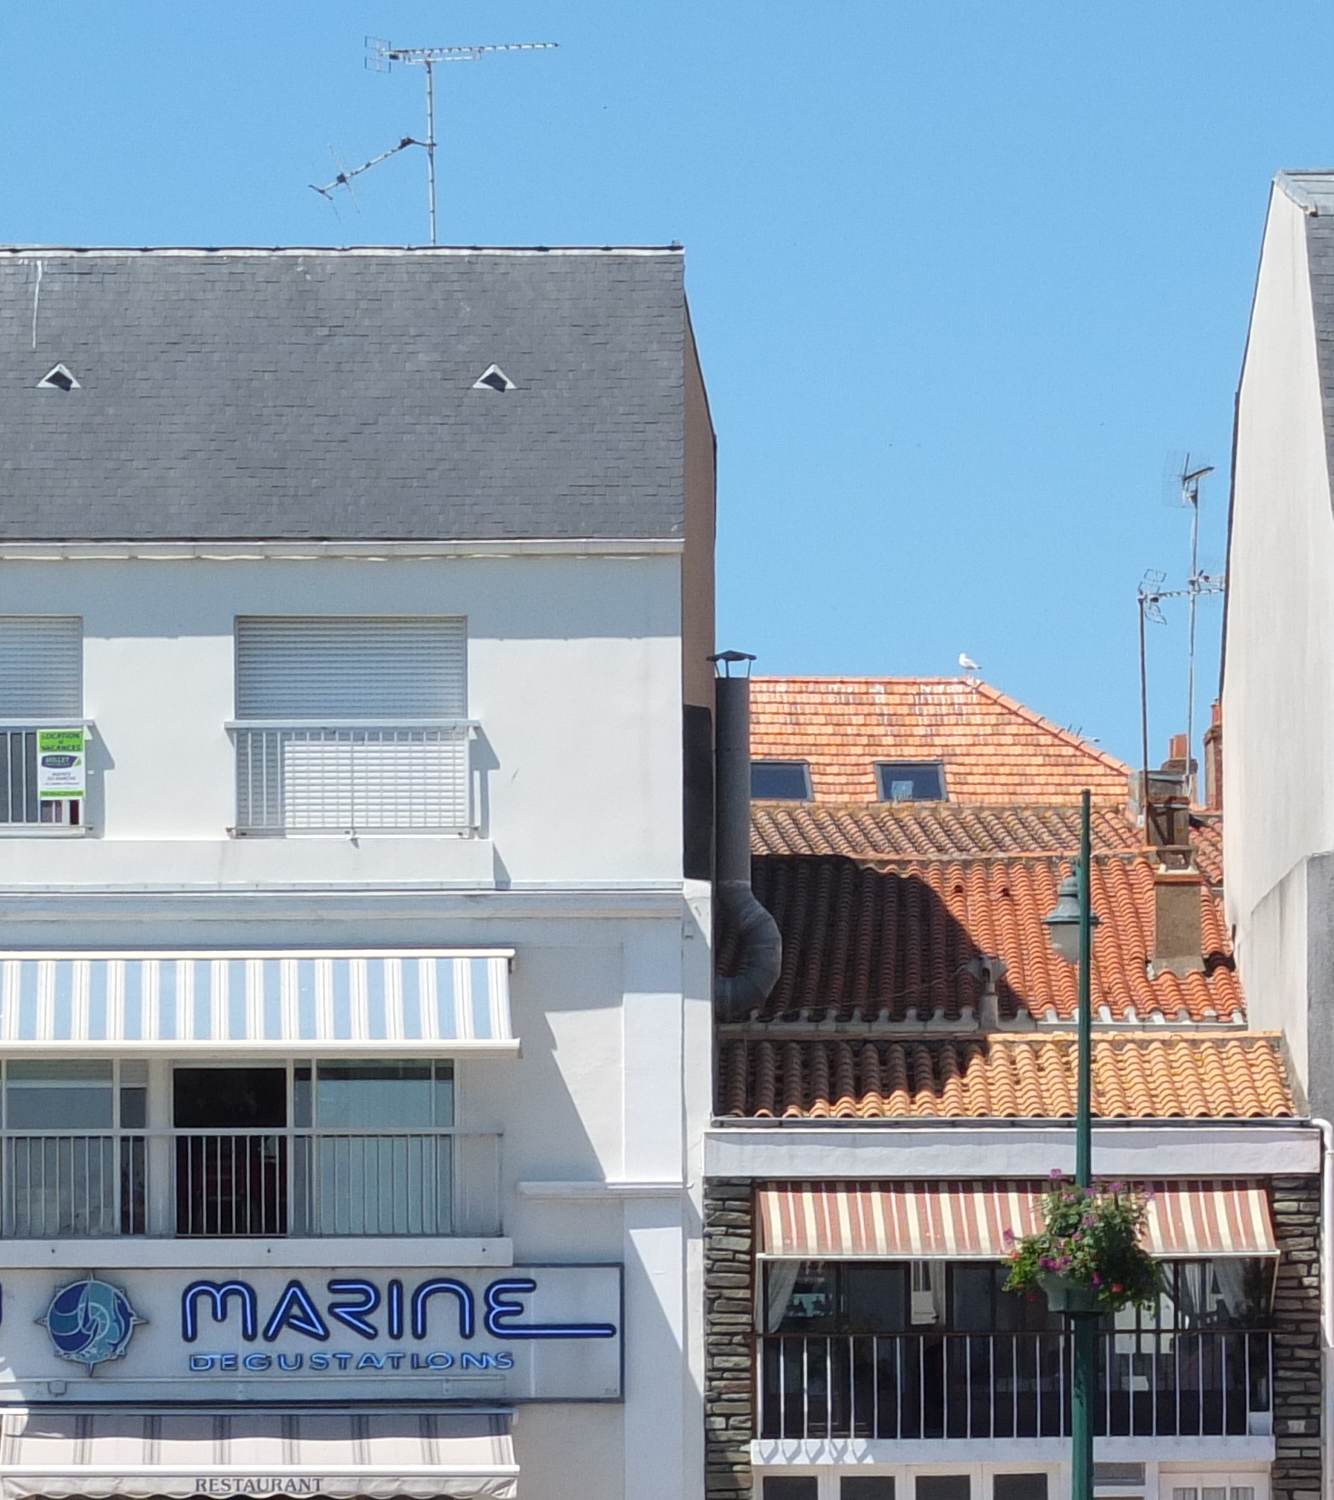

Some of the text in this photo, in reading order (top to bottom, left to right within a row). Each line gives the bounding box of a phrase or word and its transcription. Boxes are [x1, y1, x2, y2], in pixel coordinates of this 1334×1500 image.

[181, 1278, 617, 1342] MARINE
[189, 1351, 515, 1371] DEGUSTATIONS
[195, 1477, 324, 1493] RESTAURANT
